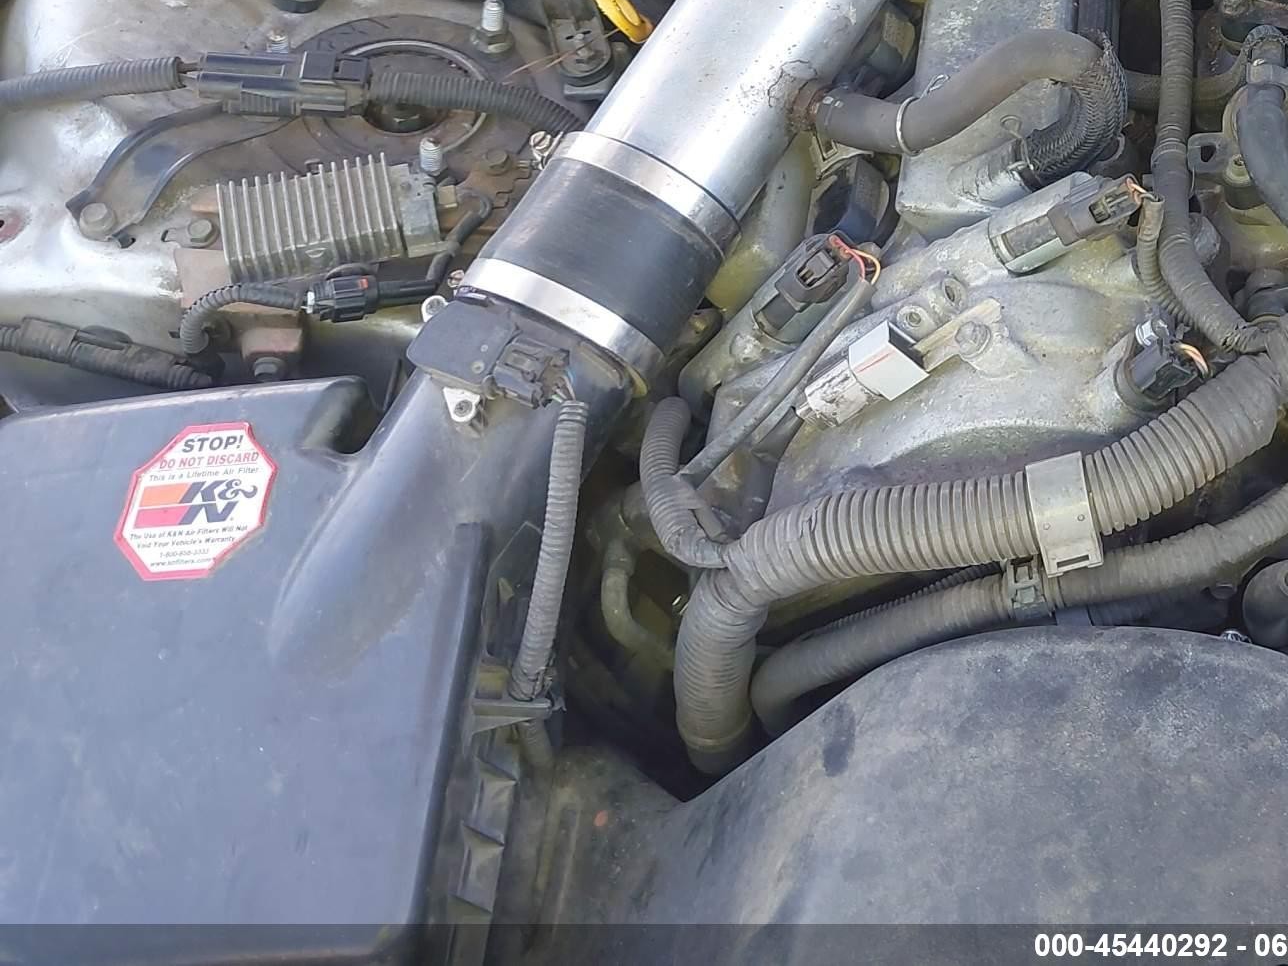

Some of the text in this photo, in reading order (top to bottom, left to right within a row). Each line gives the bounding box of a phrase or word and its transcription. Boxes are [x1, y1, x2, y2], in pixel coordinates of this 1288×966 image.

[182, 435, 244, 453] STOP!
[159, 452, 259, 469] DO NOT DISCARD
[187, 469, 220, 478] Lifetime
[238, 466, 259, 474] Filter
[178, 479, 258, 526] K&N
[167, 530, 183, 538] K&N
[197, 527, 219, 535] Filters
[171, 538, 203, 547] Vehicle's
